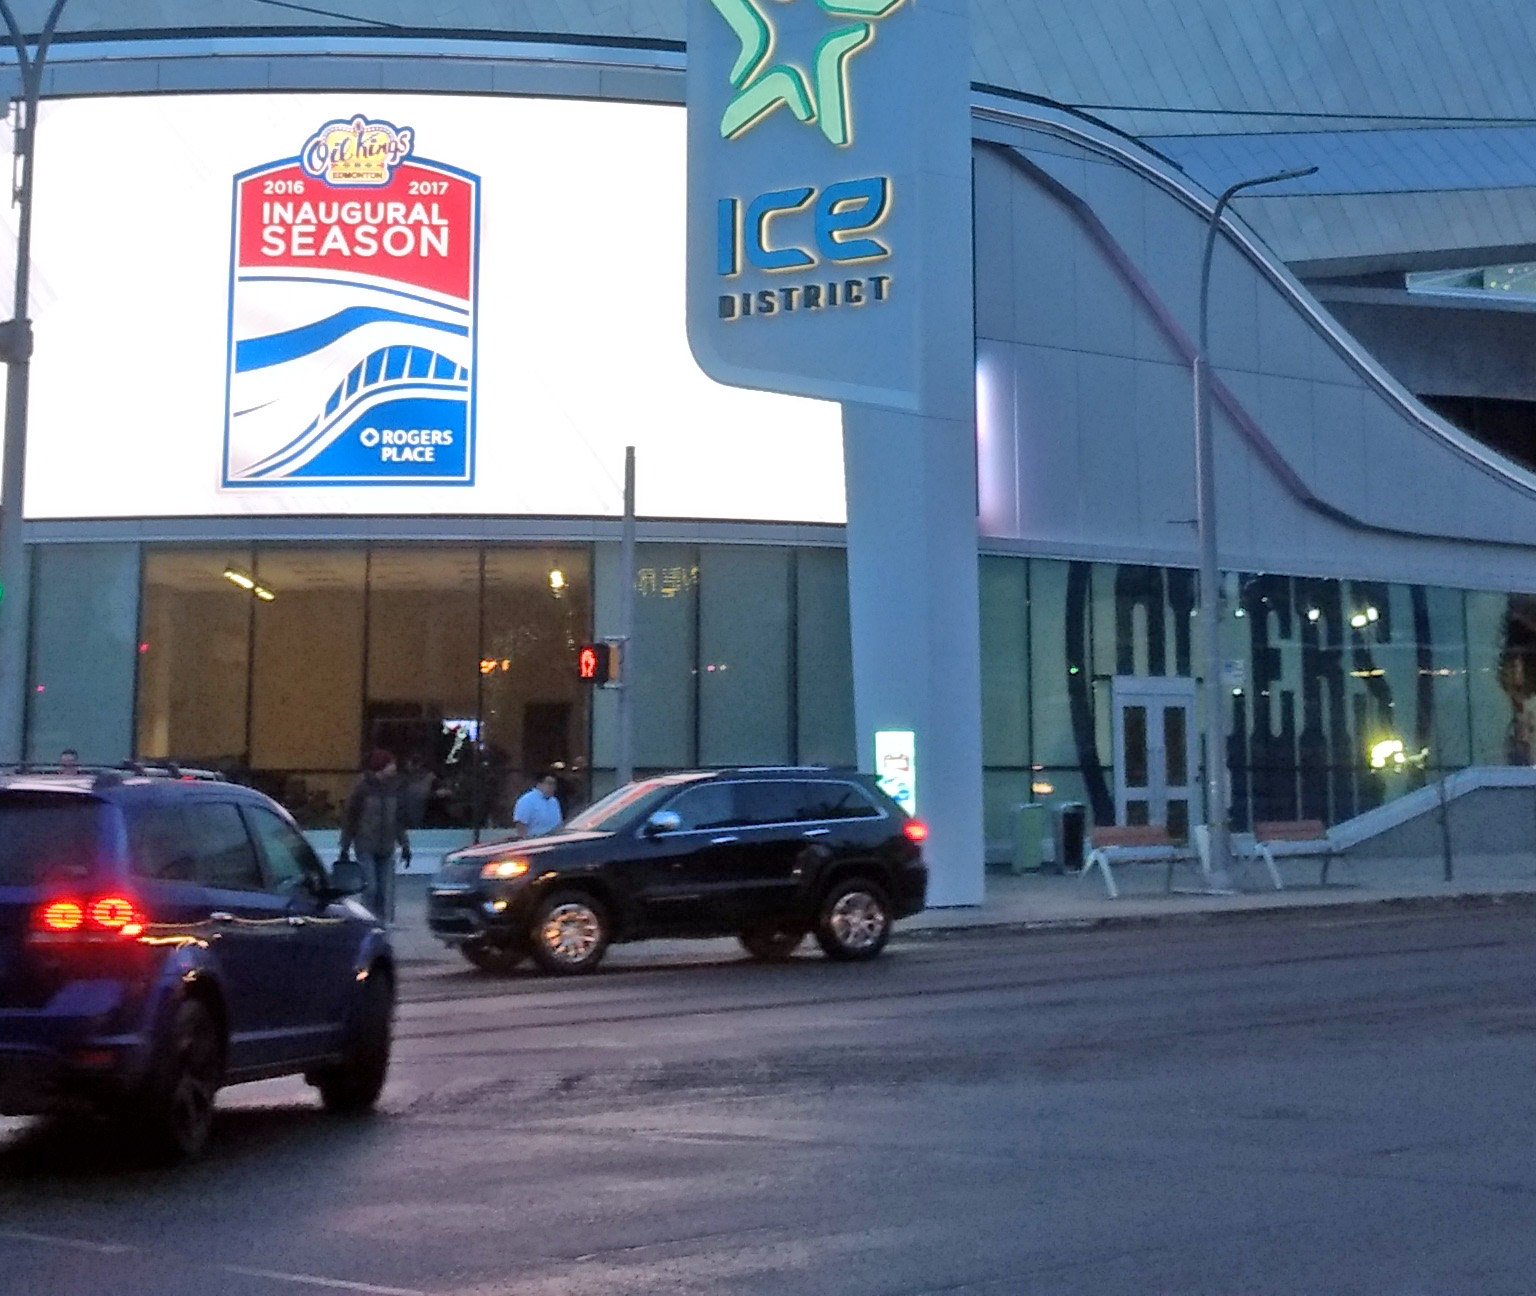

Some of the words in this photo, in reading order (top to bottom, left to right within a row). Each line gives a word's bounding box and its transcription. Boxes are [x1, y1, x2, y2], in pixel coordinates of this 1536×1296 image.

[306, 135, 353, 172] Oil
[331, 171, 383, 180] EDMONTON
[263, 180, 305, 195] 2016
[408, 181, 449, 196] 2017
[261, 201, 449, 226] INAUGURAL
[260, 224, 449, 257] SEASON
[717, 275, 891, 321] DISTRICT
[381, 429, 454, 446] ROGERS
[381, 446, 436, 462] PLACE
